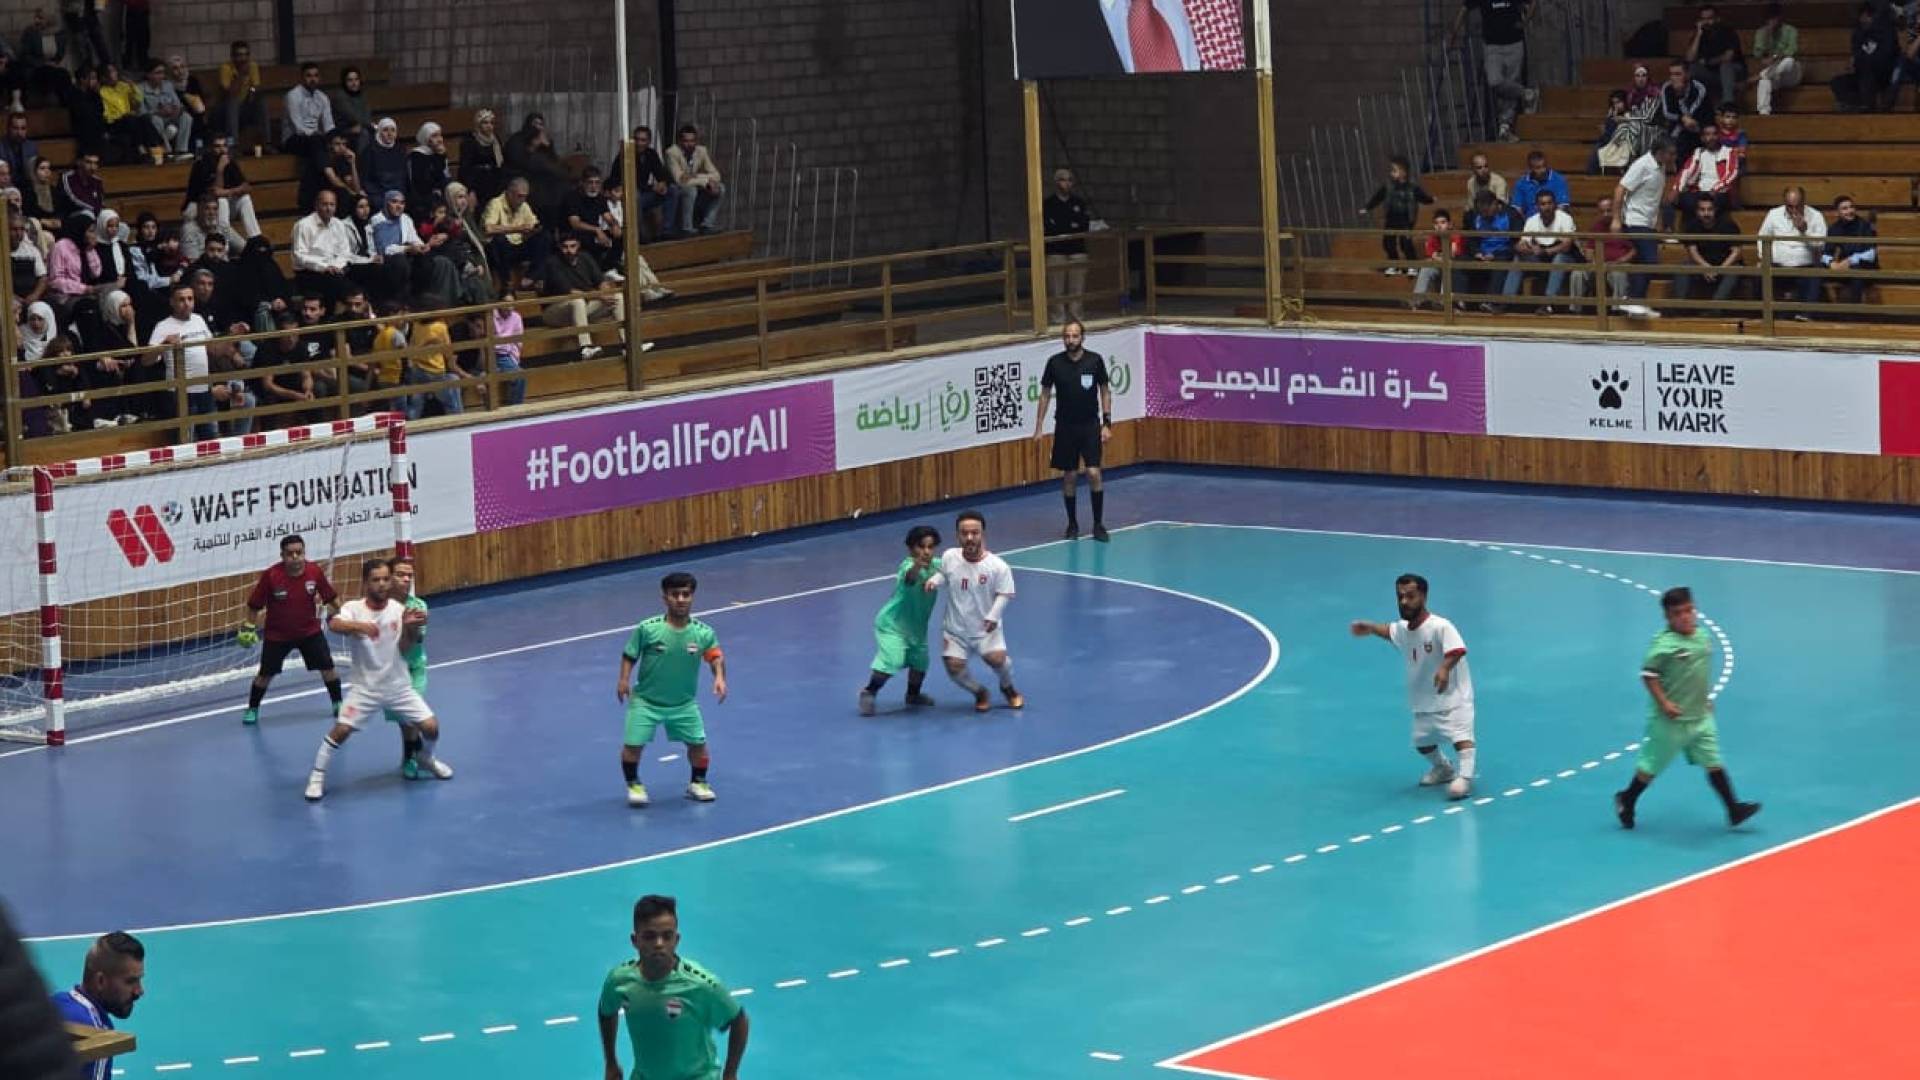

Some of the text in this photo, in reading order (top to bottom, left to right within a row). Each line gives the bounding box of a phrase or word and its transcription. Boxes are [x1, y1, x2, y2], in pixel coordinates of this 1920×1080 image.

[1656, 362, 1735, 386] LEAVE
[1180, 366, 1449, 409] كرة القدم للجميع
[1656, 386, 1723, 410] YOUR
[856, 396, 921, 431] رياضة
[1589, 417, 1633, 430] KELME
[1658, 410, 1728, 434] MARK
[526, 406, 788, 491] #FootballForAll
[191, 462, 417, 525] WAFF FOUNDATIN
[233, 528, 262, 550] القدم
